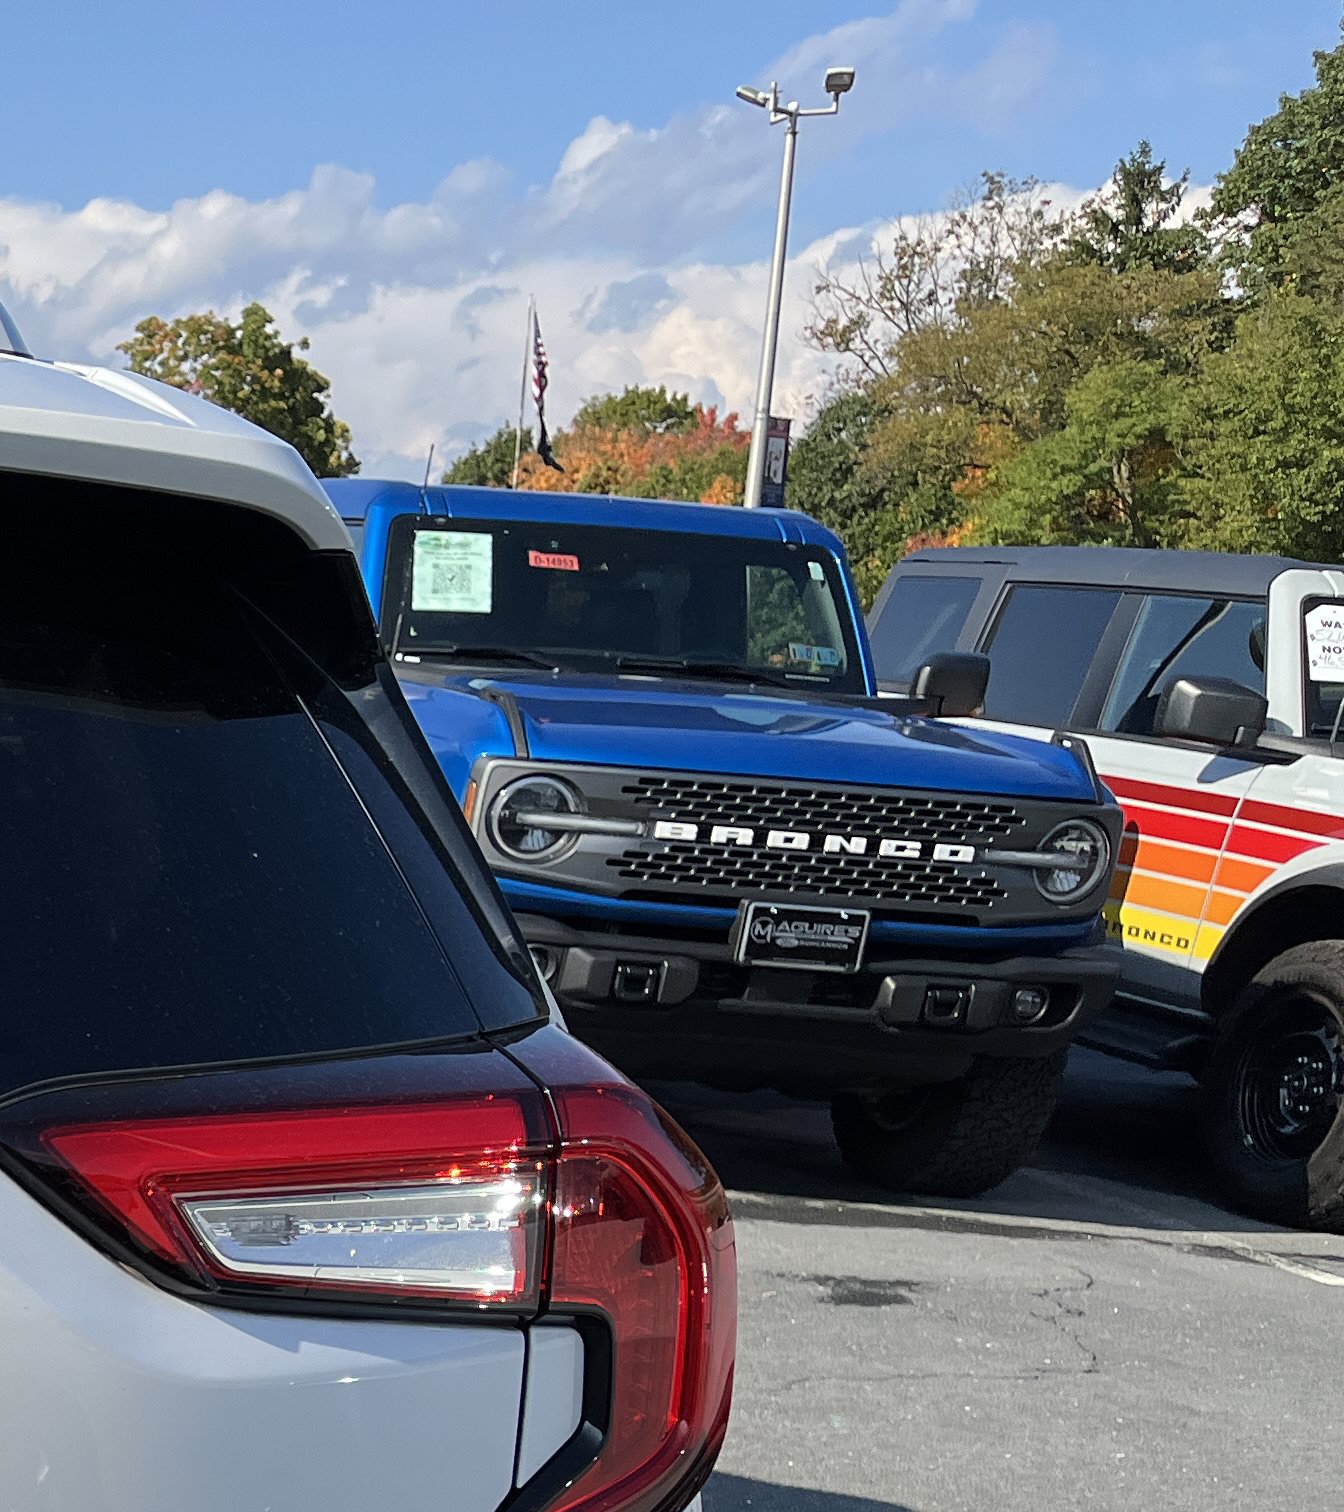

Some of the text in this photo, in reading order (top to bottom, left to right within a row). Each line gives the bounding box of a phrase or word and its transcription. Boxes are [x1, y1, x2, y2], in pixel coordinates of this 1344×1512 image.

[1320, 619, 1344, 629] WA
[1322, 645, 1344, 655] NO
[654, 820, 976, 864] BRONCO
